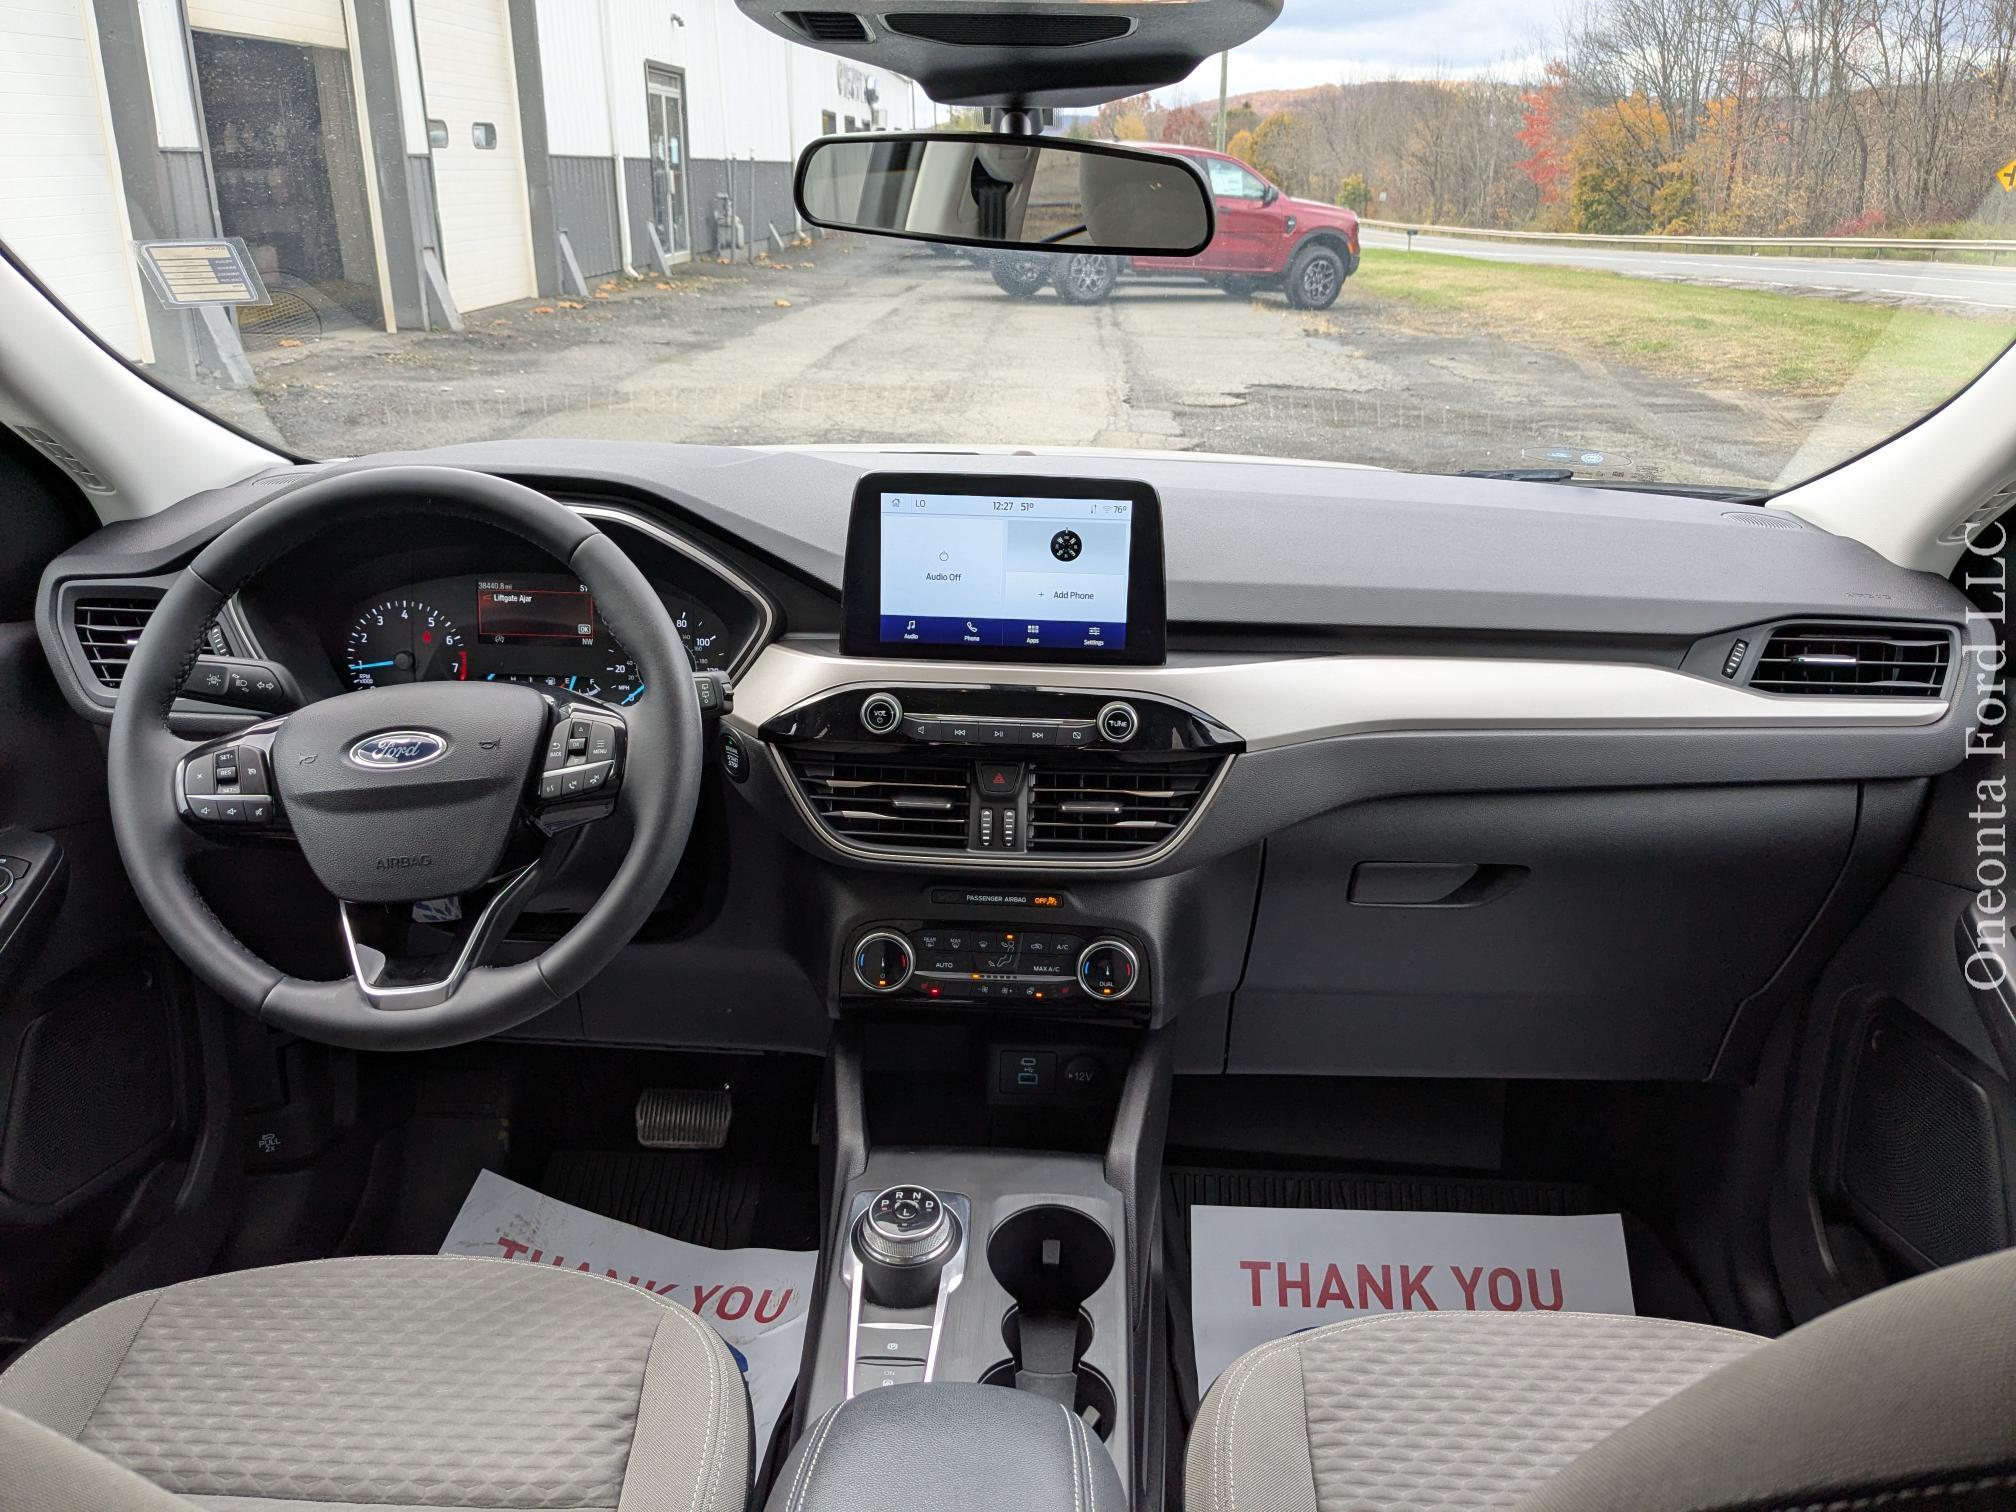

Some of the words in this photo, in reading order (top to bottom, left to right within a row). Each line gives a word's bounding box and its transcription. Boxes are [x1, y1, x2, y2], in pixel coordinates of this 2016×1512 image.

[915, 499, 926, 508] LO
[992, 501, 1014, 511] 12:27
[925, 572, 948, 581] Audio
[949, 572, 962, 582] Off
[493, 594, 518, 602] Liftgate
[519, 594, 532, 603] Ajar
[1053, 591, 1068, 600] Add
[1070, 591, 1094, 601] Phone
[401, 609, 409, 619] 4
[376, 616, 384, 626] 3
[428, 617, 435, 627] 5
[676, 619, 687, 628] 80
[361, 633, 368, 643] 2
[446, 635, 453, 645] 6
[696, 638, 711, 647] 100
[1083, 639, 1105, 647] Settings
[452, 663, 459, 673] 7
[615, 664, 625, 674] 20
[371, 738, 421, 761] Ford
[376, 855, 432, 870] AIRBAG
[896, 1191, 904, 1200] R
[913, 1191, 922, 1200] N
[881, 1199, 889, 1208] P
[925, 1200, 934, 1209] D
[903, 1208, 910, 1216] L
[1239, 1260, 1440, 1311] THANK
[1450, 1265, 1564, 1312] YOU
[691, 1284, 793, 1324] YOU
